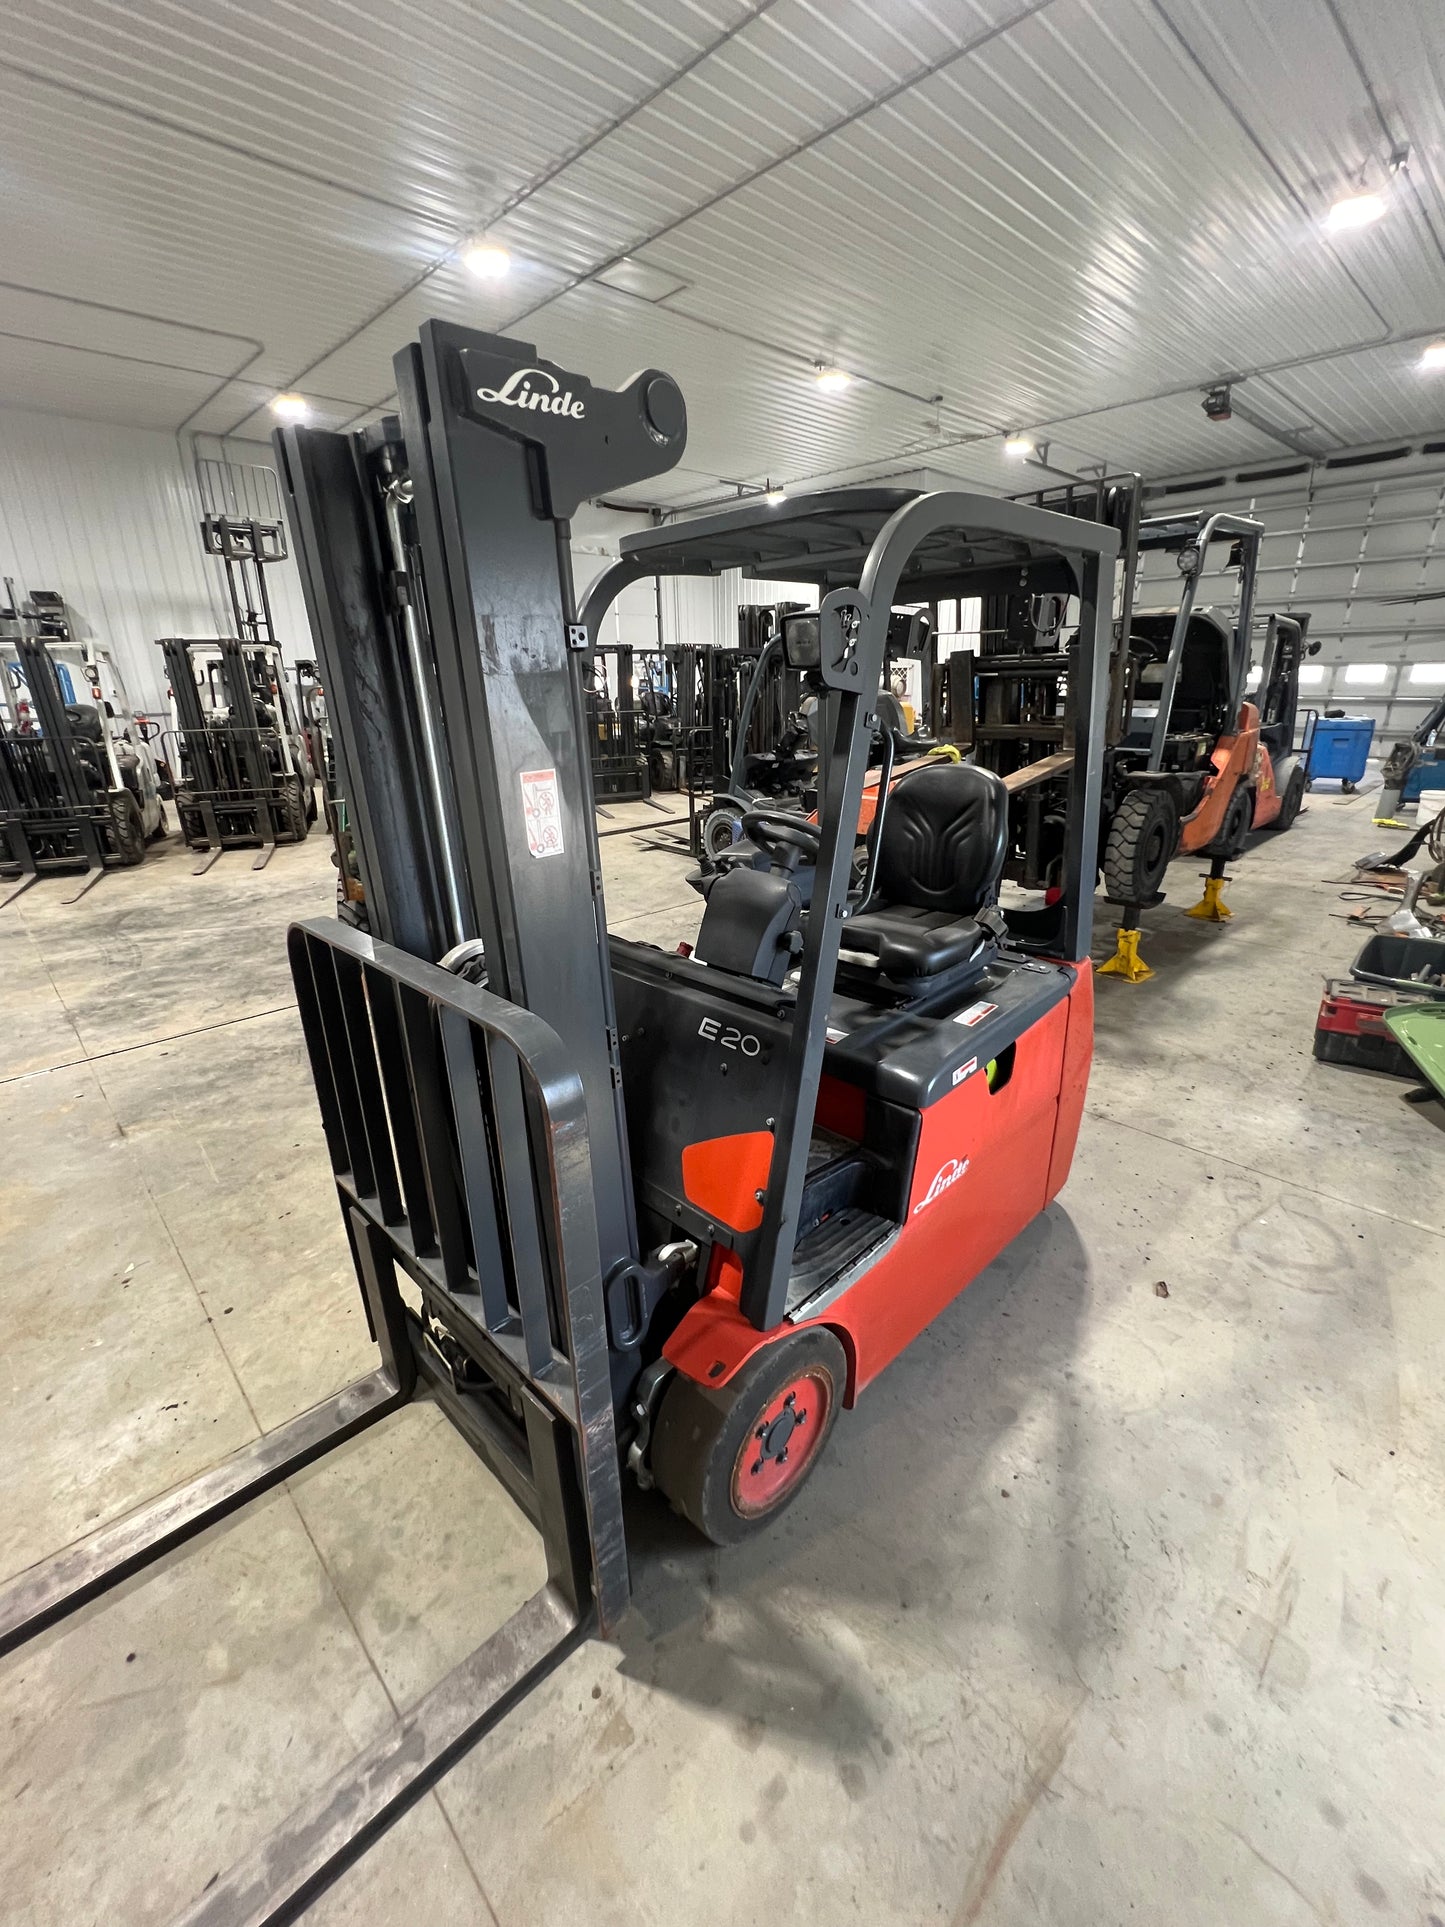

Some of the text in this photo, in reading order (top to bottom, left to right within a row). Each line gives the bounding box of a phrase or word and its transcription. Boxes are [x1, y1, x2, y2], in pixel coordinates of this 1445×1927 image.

[476, 368, 585, 420] Linde
[697, 1016, 761, 1057] E20
[913, 1158, 970, 1215] Linde
